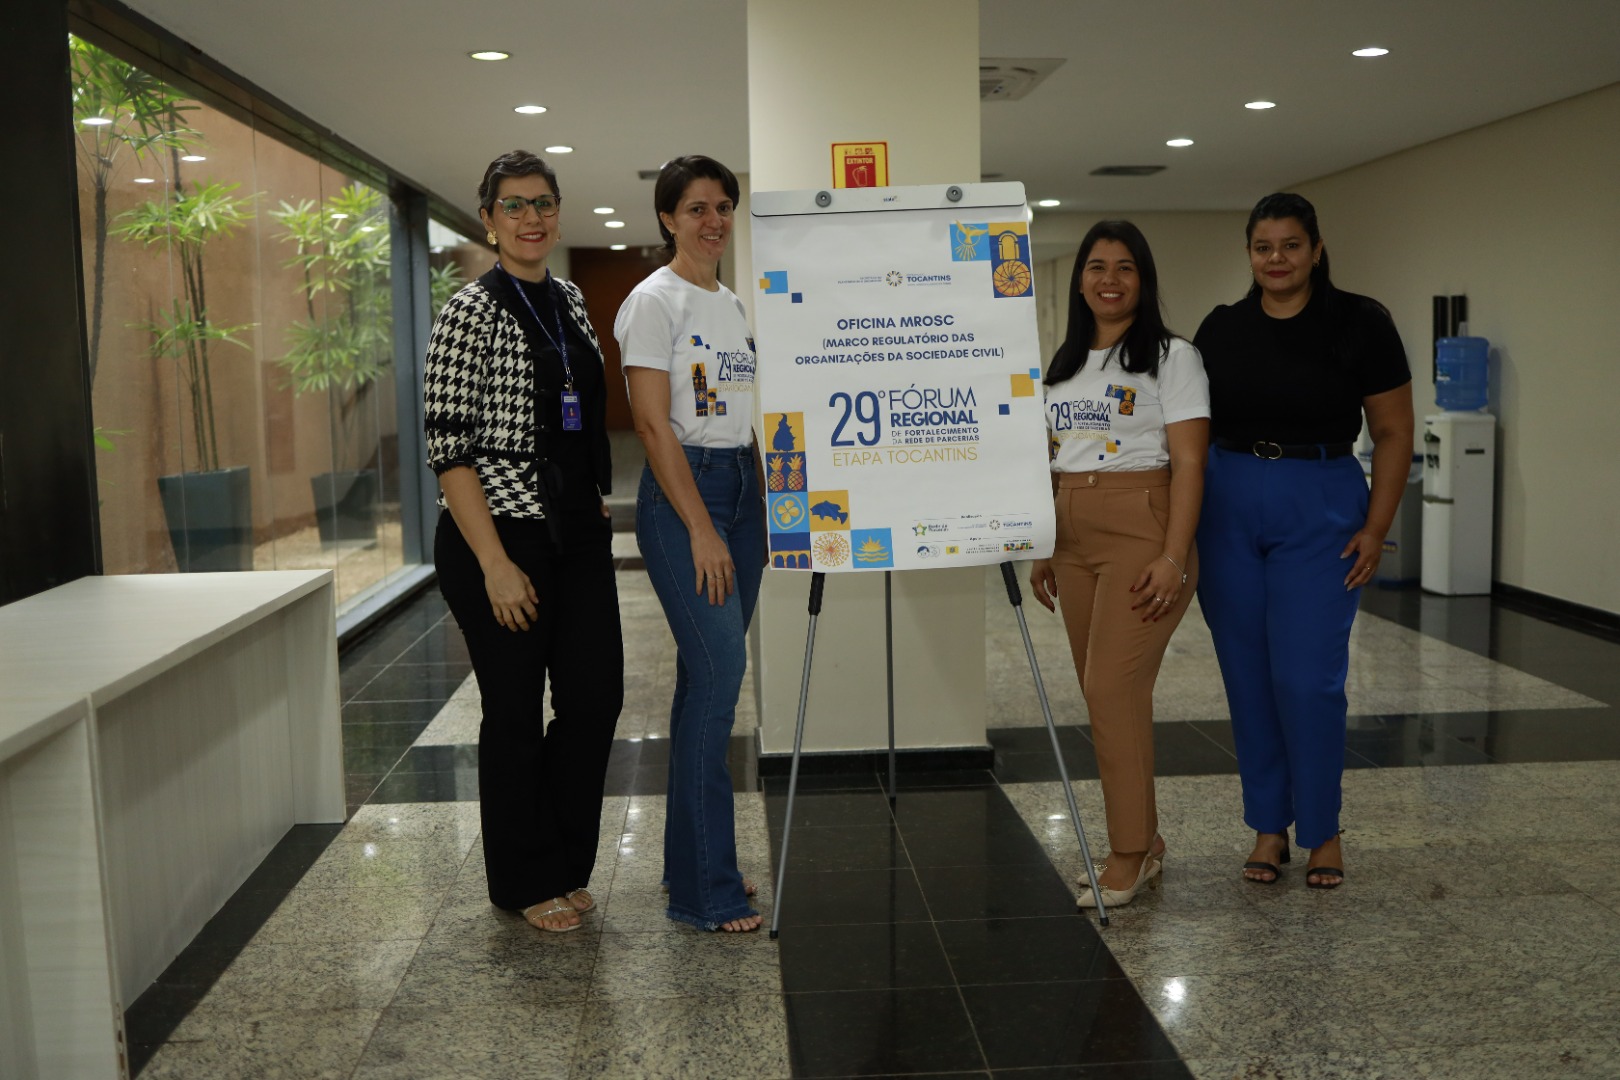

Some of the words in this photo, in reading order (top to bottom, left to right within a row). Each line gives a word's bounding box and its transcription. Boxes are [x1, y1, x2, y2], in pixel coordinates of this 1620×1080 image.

[906, 274, 951, 283] TOCANTINS
[836, 317, 897, 331] OFICINA
[900, 314, 955, 328] MROSC
[823, 337, 870, 350] (MARCO
[872, 332, 949, 346] REGULATÓRIO
[952, 332, 975, 343] DAS
[795, 351, 885, 366] ORGANIZAÇÕES
[887, 351, 904, 362] DA
[906, 348, 969, 361] SOCIEDADE
[971, 346, 1004, 359] CIVIL)
[888, 383, 978, 411] FÓRUM
[1072, 397, 1112, 415] FÓRUM
[890, 409, 979, 428] REGIONAL
[1073, 411, 1111, 423] REGIONAL
[904, 427, 979, 437] FORTALECIMENTO
[904, 436, 923, 445] REDE
[925, 436, 935, 444] DE
[936, 434, 980, 443] PARCERIAS
[833, 451, 883, 467] ETAPA
[886, 446, 978, 464] TOCANTINS
